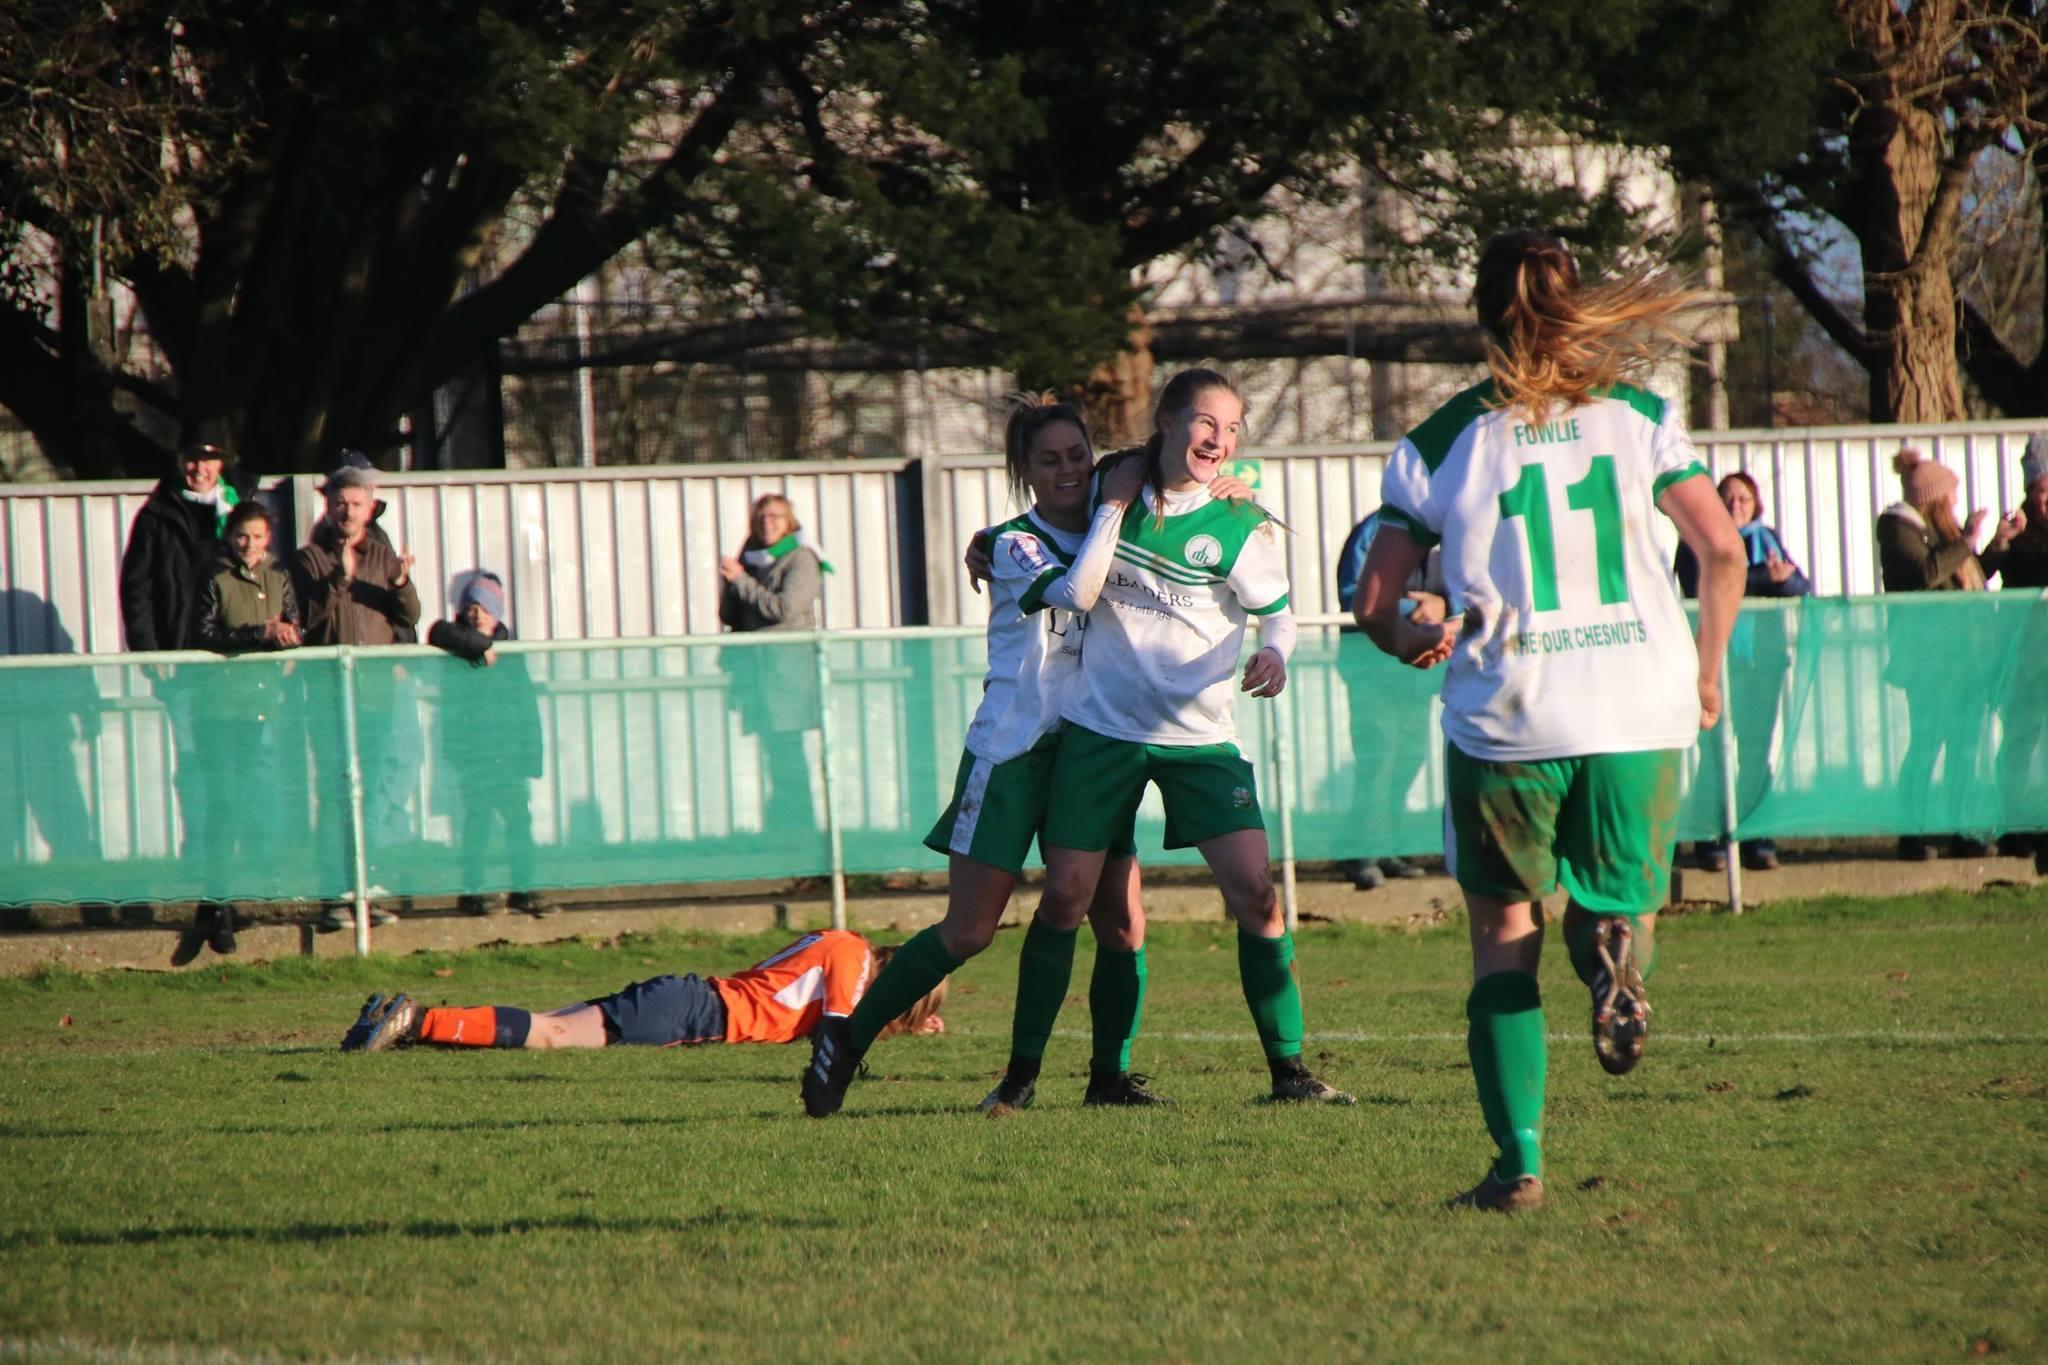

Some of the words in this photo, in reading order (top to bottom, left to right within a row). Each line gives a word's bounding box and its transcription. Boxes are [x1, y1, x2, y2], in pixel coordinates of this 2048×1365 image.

[1514, 418, 1582, 447] FOWLIE
[1498, 454, 1629, 612] 11
[1575, 619, 1647, 648] CHESNUTS
